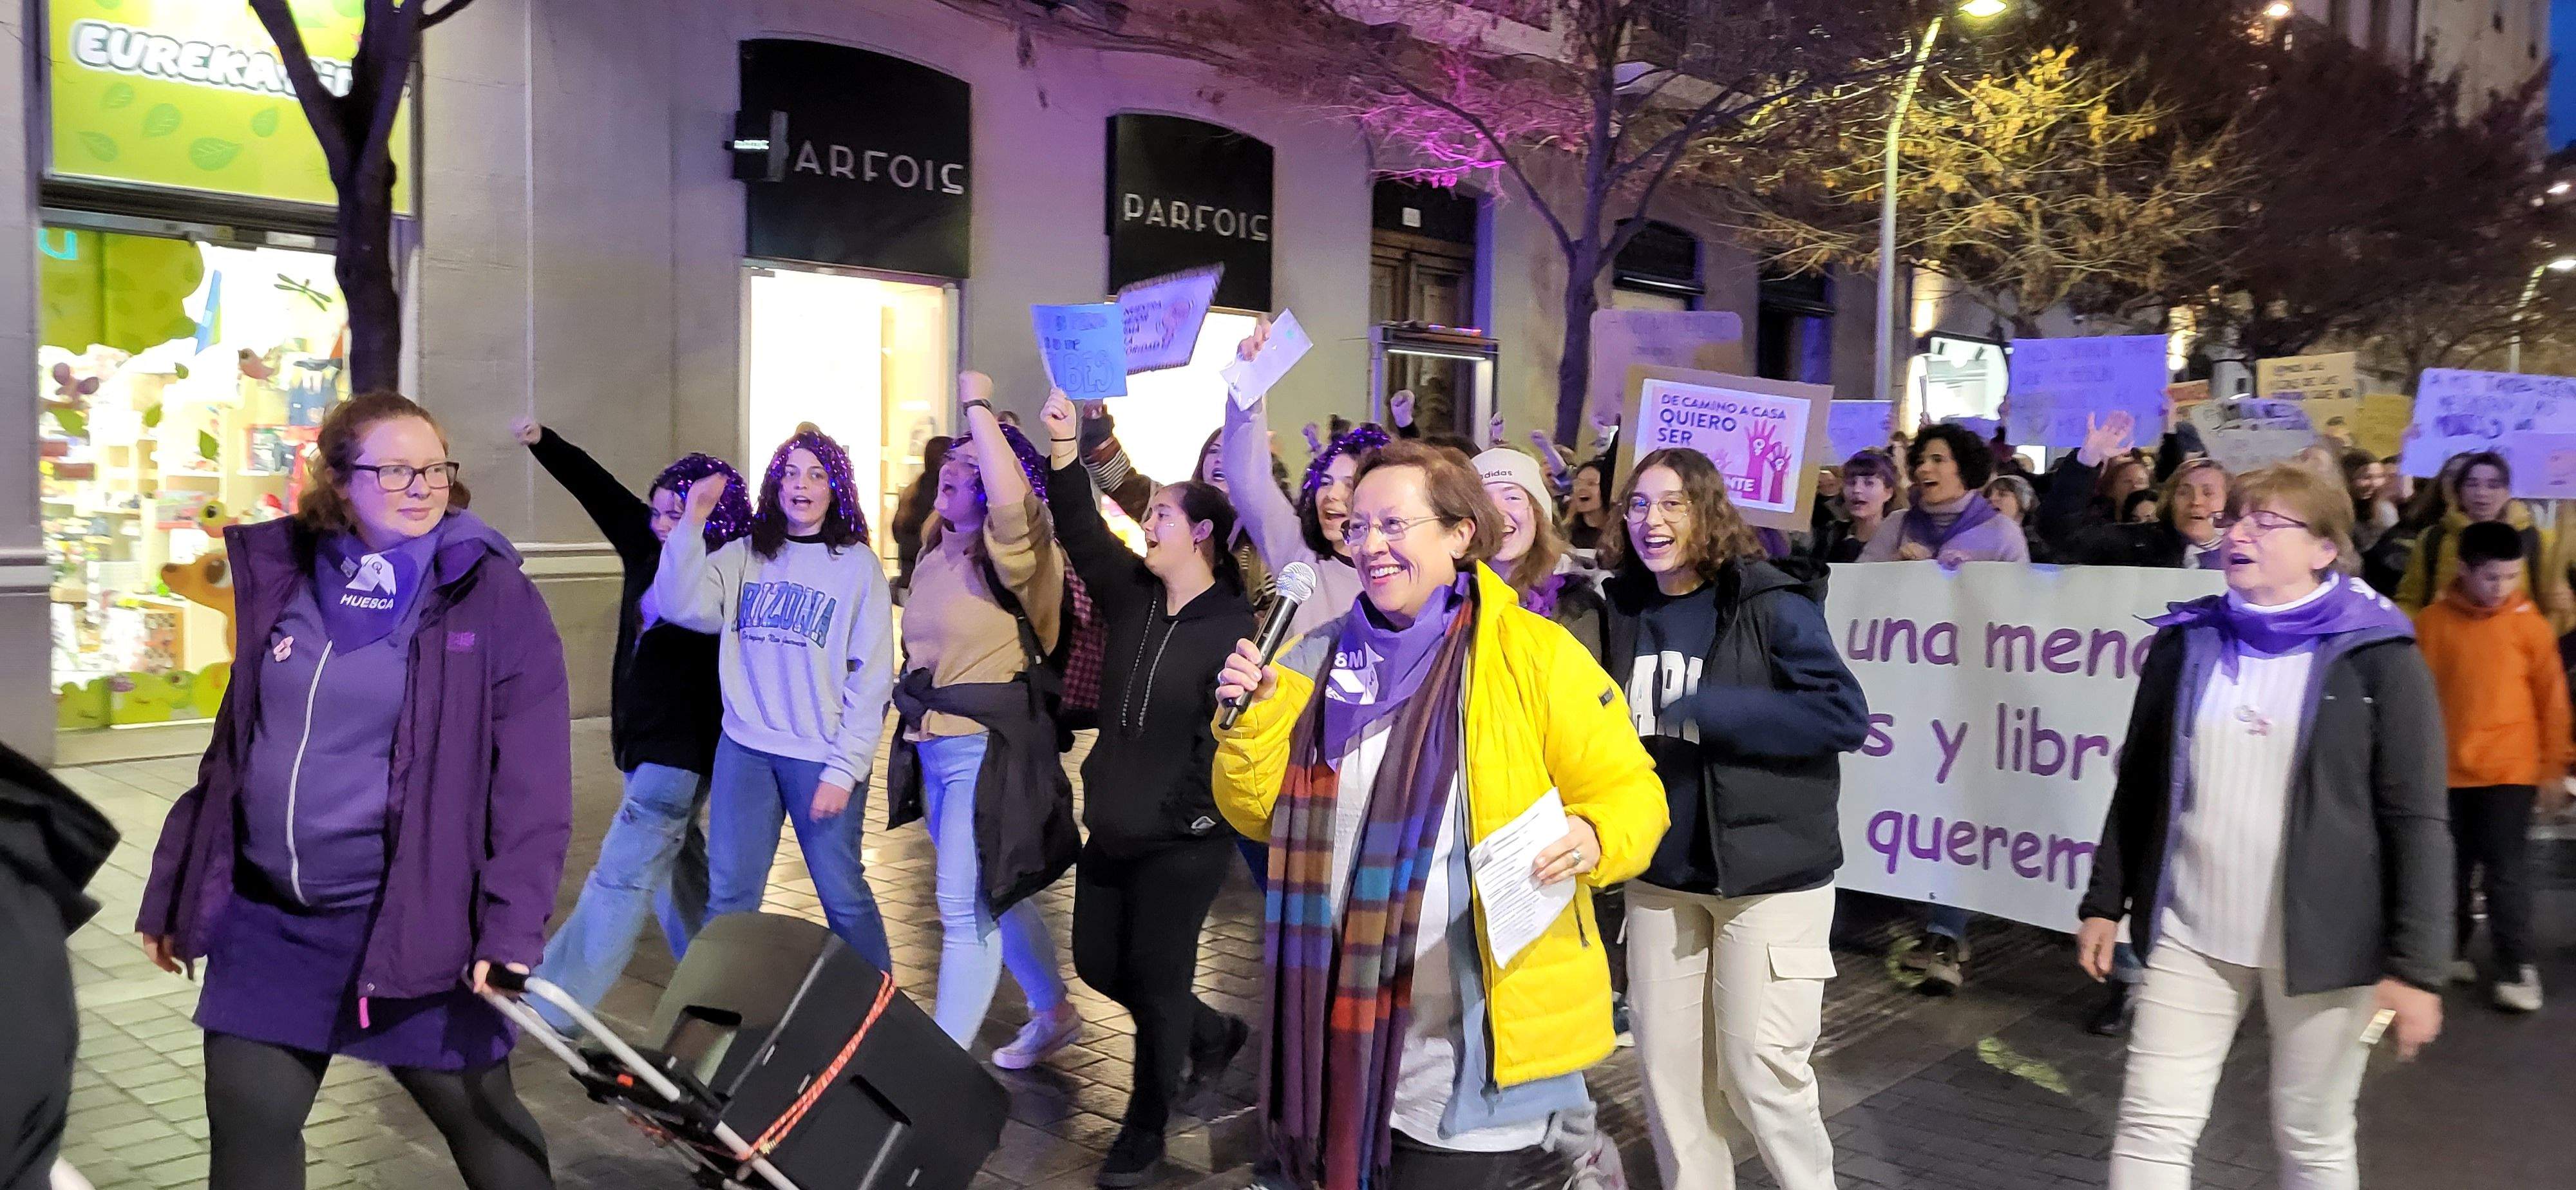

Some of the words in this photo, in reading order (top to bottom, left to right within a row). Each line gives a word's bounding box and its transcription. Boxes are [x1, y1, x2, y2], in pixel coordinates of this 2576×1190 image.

[792, 140, 965, 195] ARFOIS
[1123, 193, 1269, 241] PARFOIS
[1660, 408, 1738, 432] QUIERO
[1661, 393, 1680, 406] DE
[1681, 396, 1738, 414] CAMINO
[1739, 405, 1749, 415] A
[1751, 406, 1787, 420] CASA
[1656, 426, 1694, 446] SER
[1334, 648, 1363, 668] 8M
[1847, 616, 1958, 666] una
[1931, 719, 1968, 784] y
[1996, 703, 2124, 780] libr
